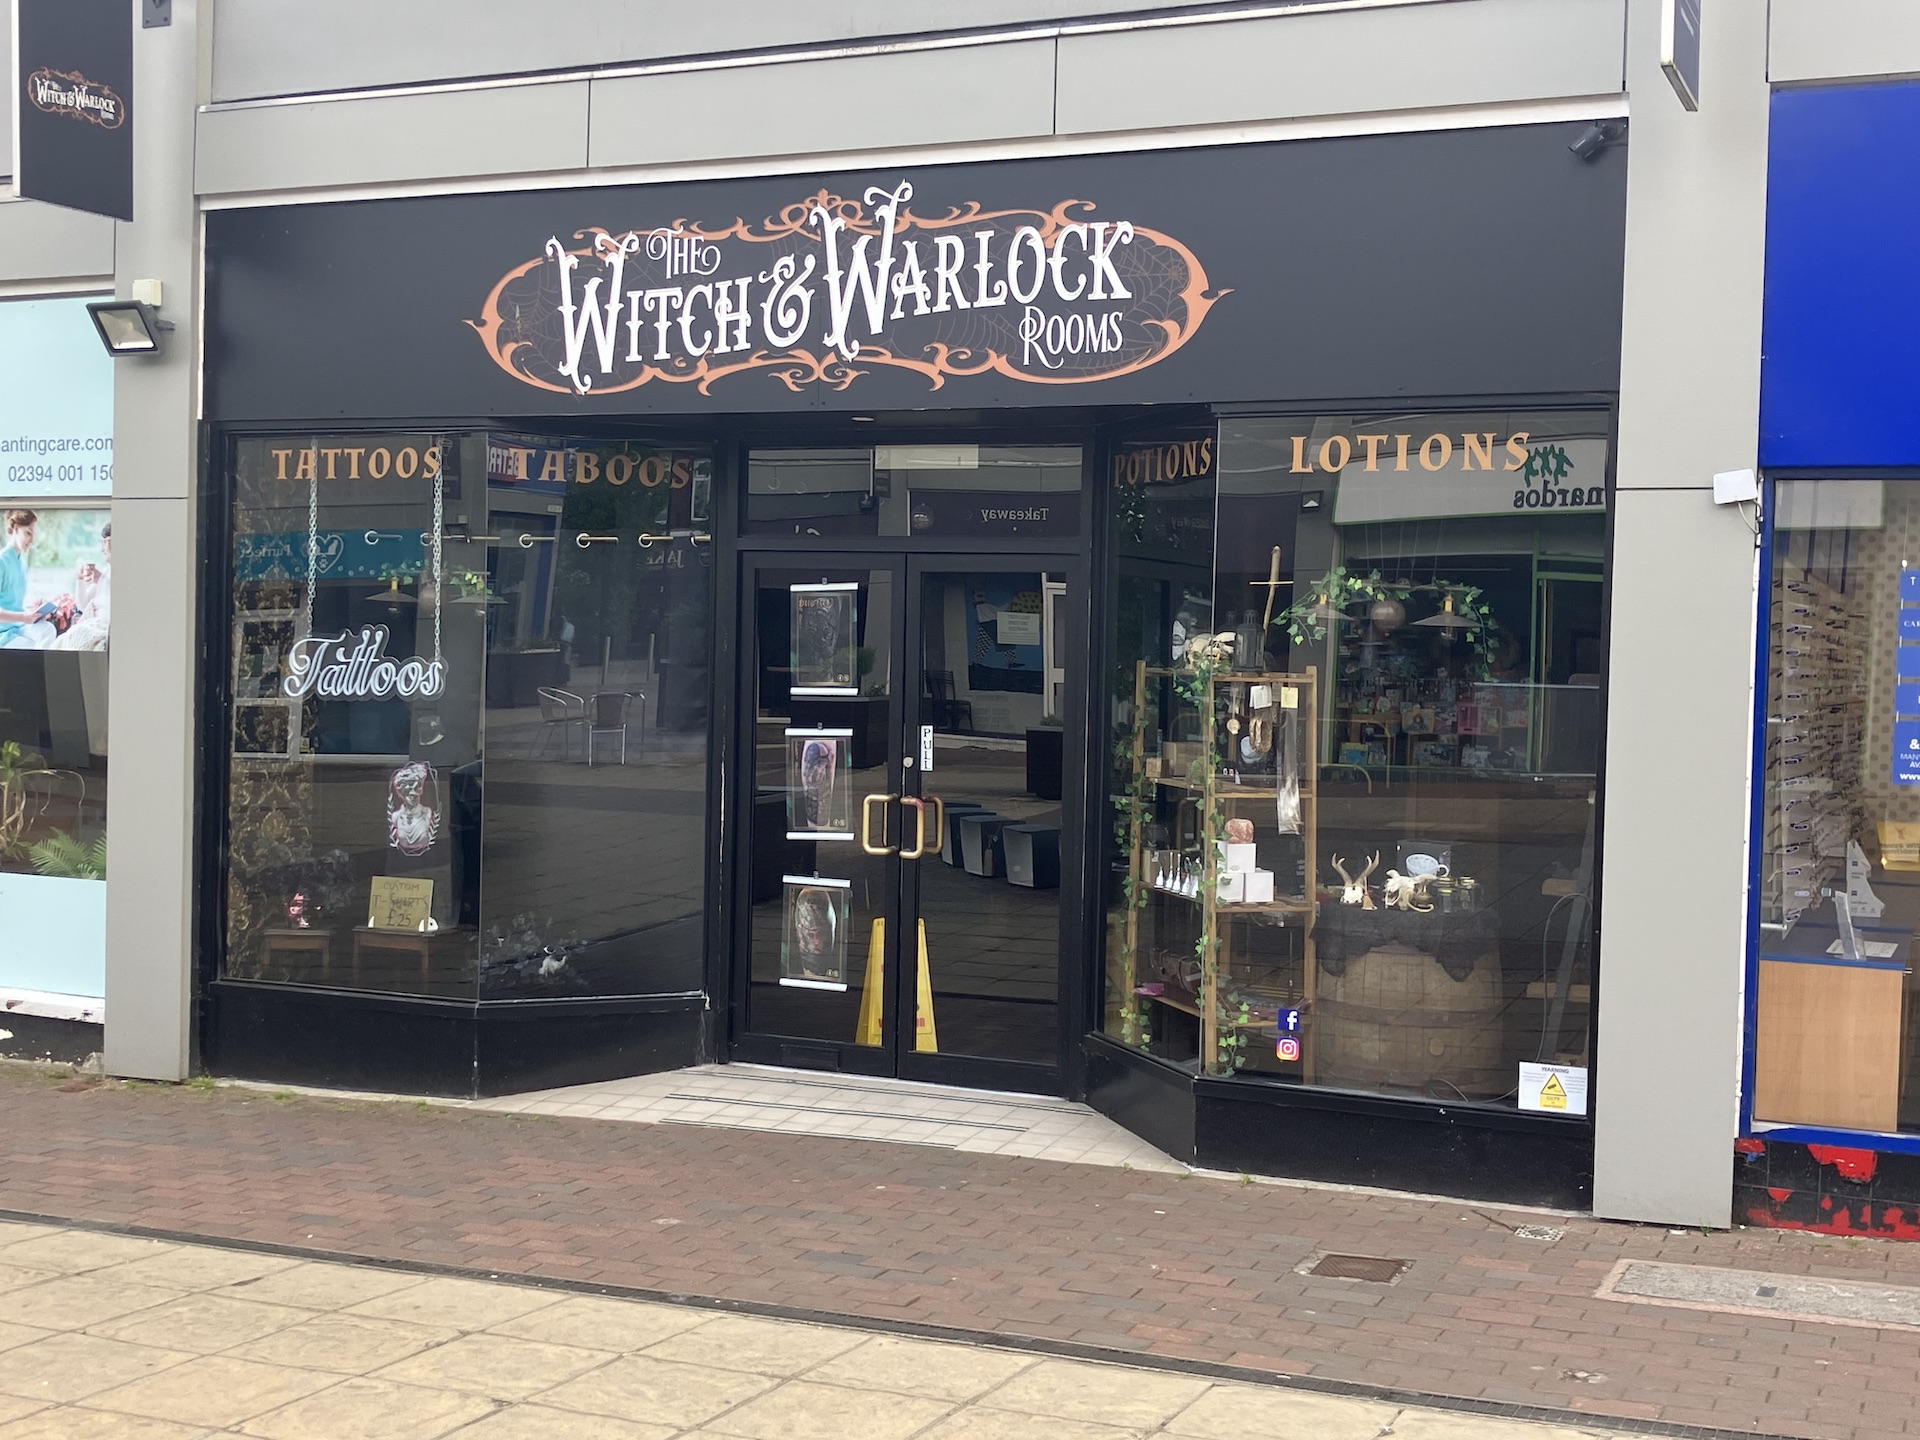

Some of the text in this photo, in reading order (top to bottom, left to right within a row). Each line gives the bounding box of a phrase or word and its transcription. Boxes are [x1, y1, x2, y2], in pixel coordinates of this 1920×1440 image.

[73, 85, 115, 113] WARLOCK
[646, 225, 721, 279] THE
[545, 179, 1134, 395] WITCH & WARLOCK
[1019, 305, 1124, 370] ROOMS
[272, 447, 441, 480] TATTOOS
[508, 448, 691, 489] TABOOS
[1114, 437, 1212, 488] POTIONS
[1289, 432, 1530, 473] LOTIONS
[8, 465, 53, 482] 02394
[58, 465, 84, 482] 001
[284, 630, 443, 697] Tattoos
[923, 728, 932, 770] PULL
[383, 880, 420, 892] CUSTOM
[386, 908, 412, 927] £25
[1541, 1066, 1570, 1074] WARNING
